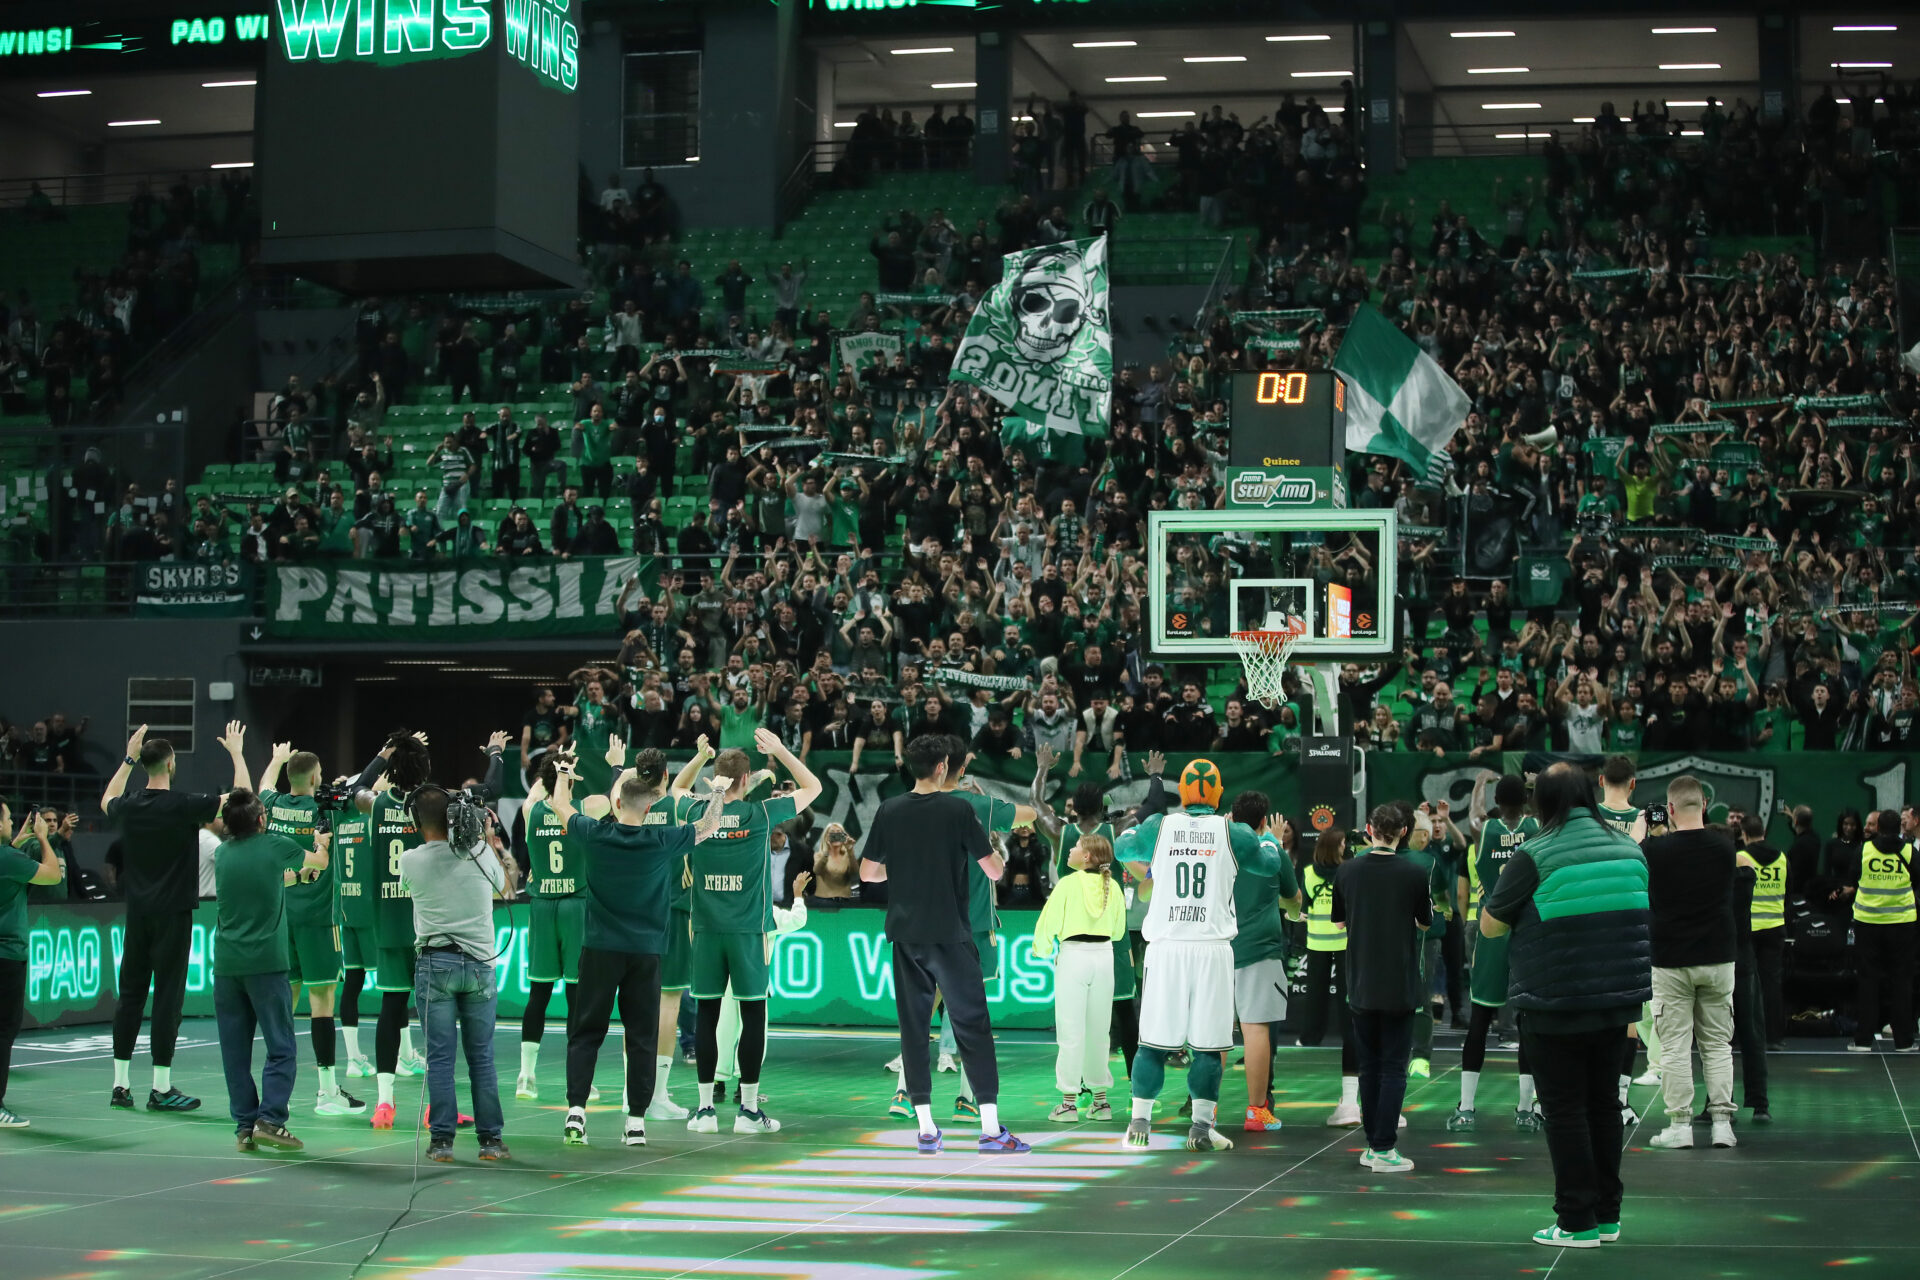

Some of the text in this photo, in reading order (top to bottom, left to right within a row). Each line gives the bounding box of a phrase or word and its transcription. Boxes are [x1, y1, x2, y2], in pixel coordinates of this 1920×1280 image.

[171, 17, 225, 44] PAO
[504, 0, 579, 91] WINS
[1256, 372, 1308, 404] 0:0
[1263, 457, 1300, 467] Quince
[275, 557, 645, 627] PATISSIA
[1309, 749, 1341, 757] SPALDING
[1174, 831, 1215, 844] MR. GREEN
[1500, 832, 1526, 847] GRANT
[389, 839, 404, 876] 8
[548, 840, 564, 874] 6
[1169, 846, 1217, 857] instacar
[345, 848, 355, 878] 5
[1868, 858, 1903, 874] CSI
[540, 878, 575, 894] ATHENS
[704, 874, 743, 892] ATHENS
[1175, 862, 1207, 899] 08
[1169, 905, 1207, 923] ATHENS
[29, 926, 101, 1001] PAO
